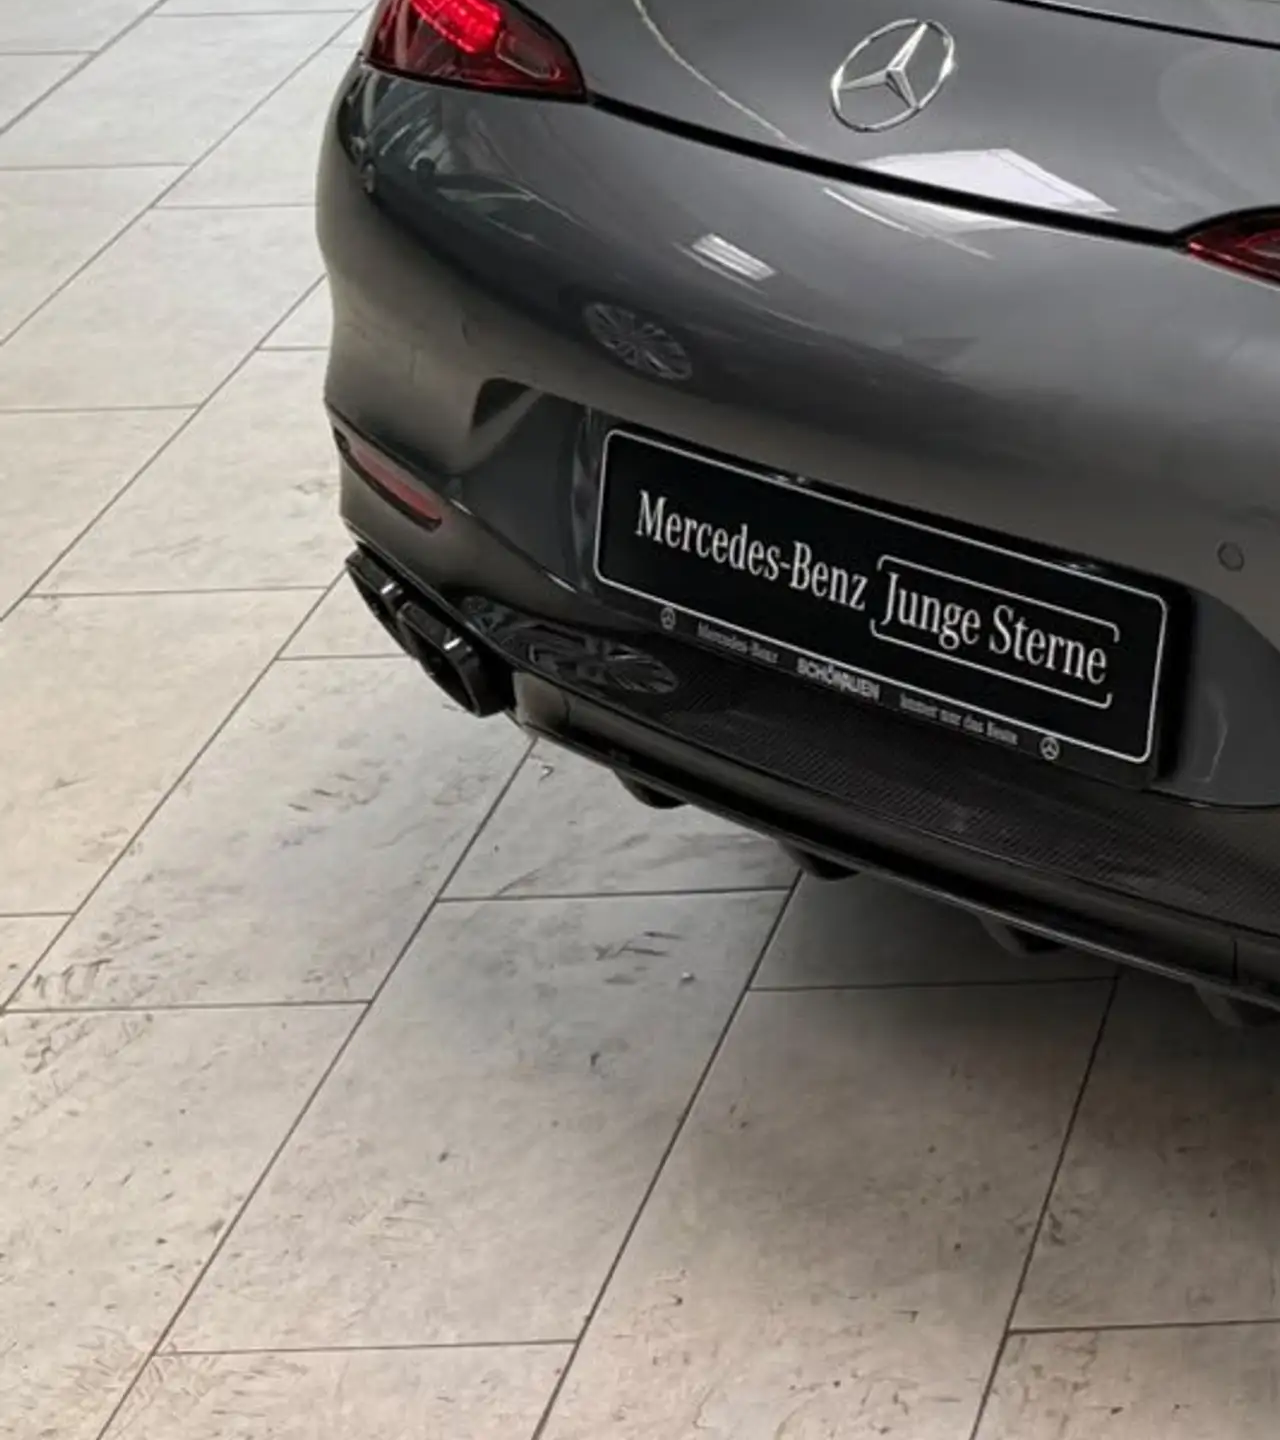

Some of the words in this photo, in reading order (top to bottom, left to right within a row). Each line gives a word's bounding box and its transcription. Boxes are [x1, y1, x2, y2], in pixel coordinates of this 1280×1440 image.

[634, 490, 866, 612] Mercedes-Benz
[881, 571, 981, 650] Junge
[988, 605, 1108, 685] Sterne
